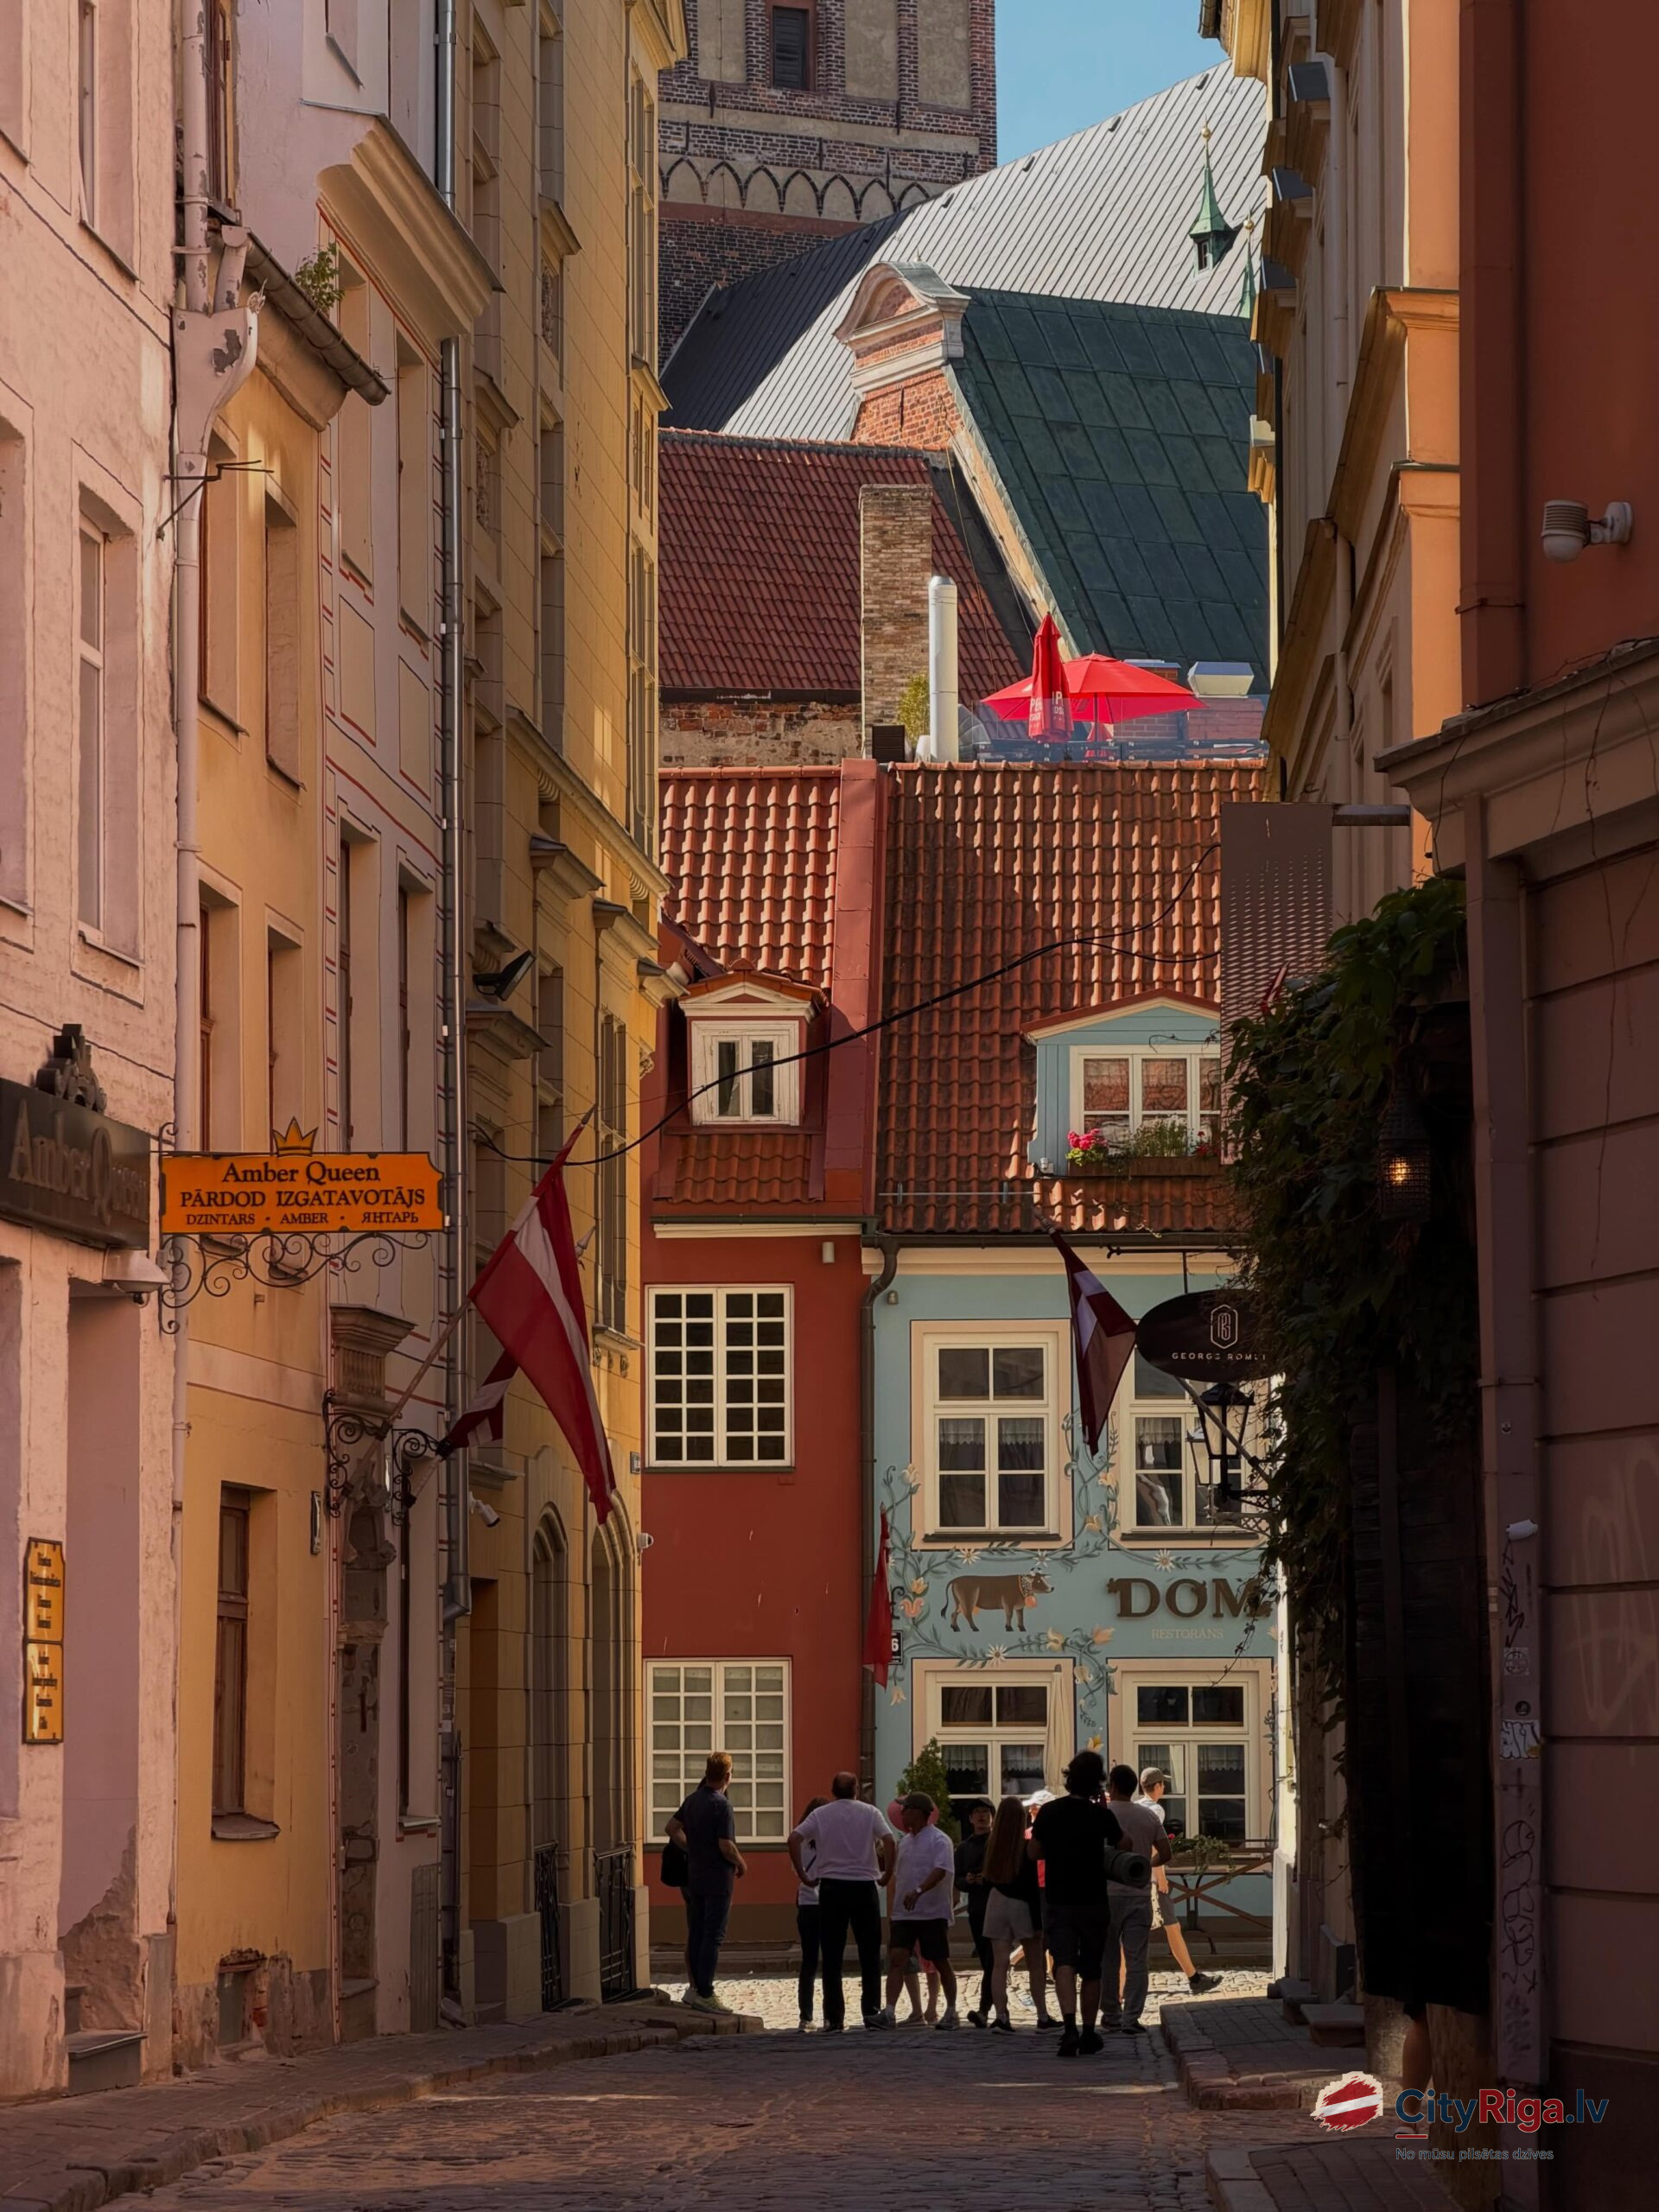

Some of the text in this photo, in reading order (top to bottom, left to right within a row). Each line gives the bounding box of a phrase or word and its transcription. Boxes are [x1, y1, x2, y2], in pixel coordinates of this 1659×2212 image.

[9, 1097, 91, 1201] Amber
[221, 1160, 381, 1185] Amber Queen
[180, 1185, 425, 1208] PĀRDOD IZGATAVOTĀJS
[186, 1212, 329, 1225] DZINTARS AMBER
[361, 1211, 419, 1224] ЯНТАРЬ
[1107, 1577, 1272, 1618] DOM
